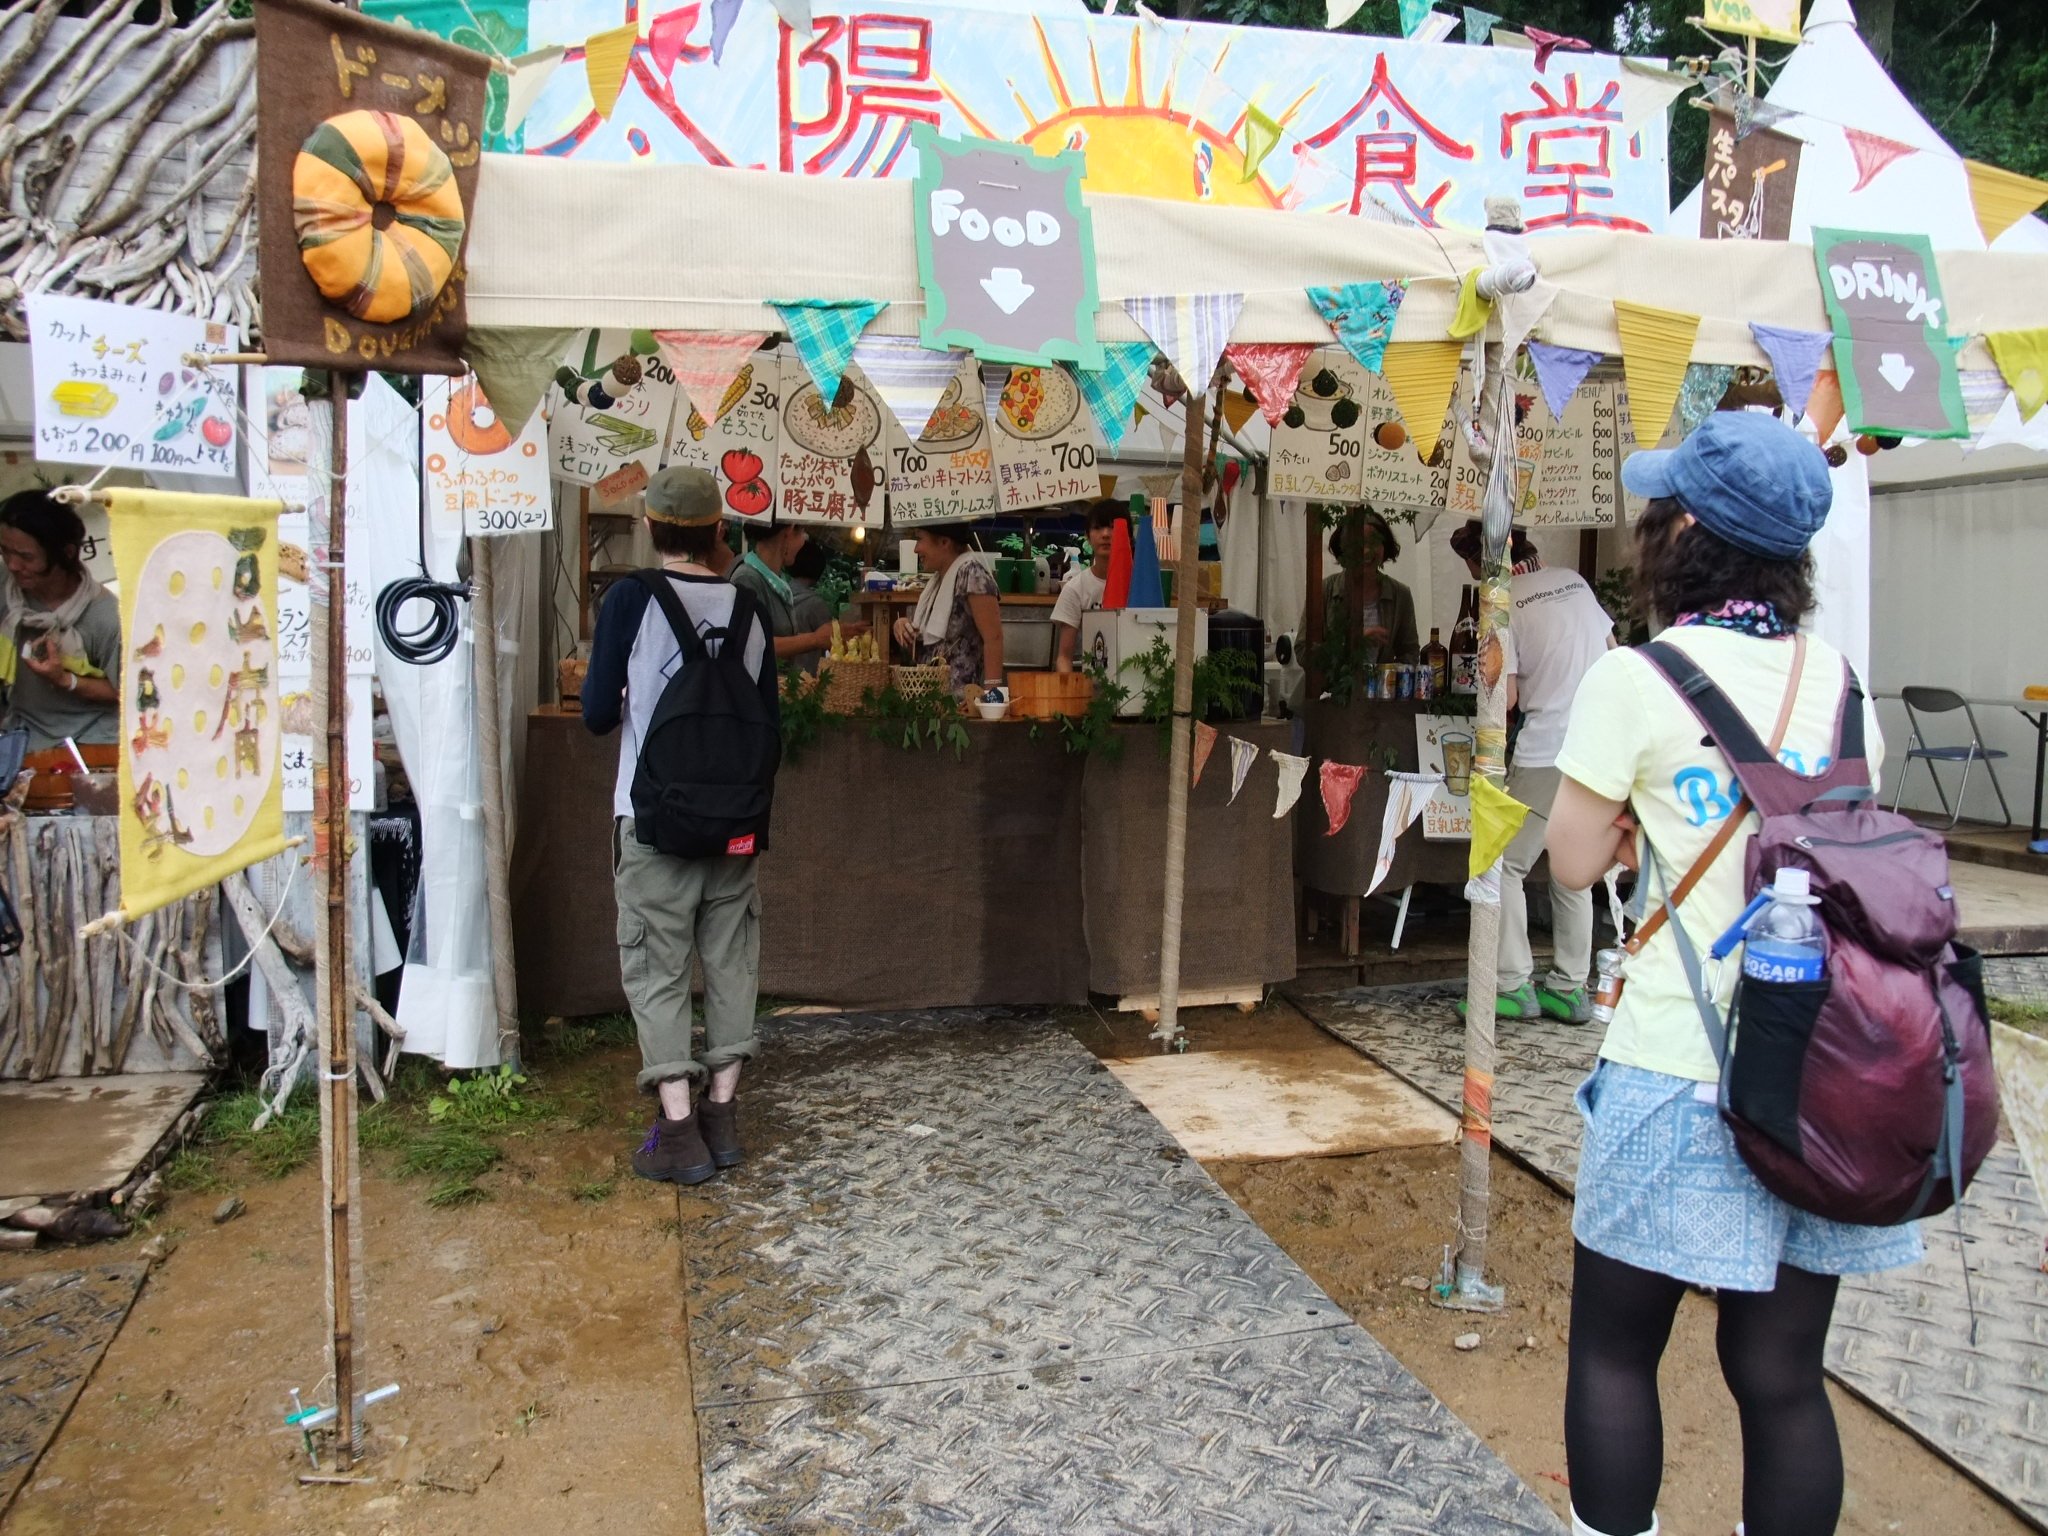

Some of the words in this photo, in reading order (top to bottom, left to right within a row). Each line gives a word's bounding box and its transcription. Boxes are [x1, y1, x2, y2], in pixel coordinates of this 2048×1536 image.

[329, 32, 480, 168] ドーナツ
[930, 188, 1061, 248] FOOD
[1829, 261, 1942, 329] DRINK
[49, 320, 91, 343] カット
[92, 334, 149, 365] チーズ
[1577, 387, 1601, 399] MENU
[1593, 400, 1613, 418] 600
[722, 416, 774, 442] もろこし
[1592, 421, 1612, 438] 600
[1329, 433, 1361, 458] 500
[1592, 440, 1613, 458] 600
[559, 454, 608, 480] セロリ
[893, 447, 927, 474] 700
[950, 448, 992, 469] 生パスタ
[1051, 442, 1095, 472] 700
[1276, 449, 1310, 465] 冷たい
[437, 468, 519, 488] ふわふわの
[1592, 463, 1613, 480] 600
[1592, 485, 1613, 504] 600
[1594, 508, 1613, 523] 500
